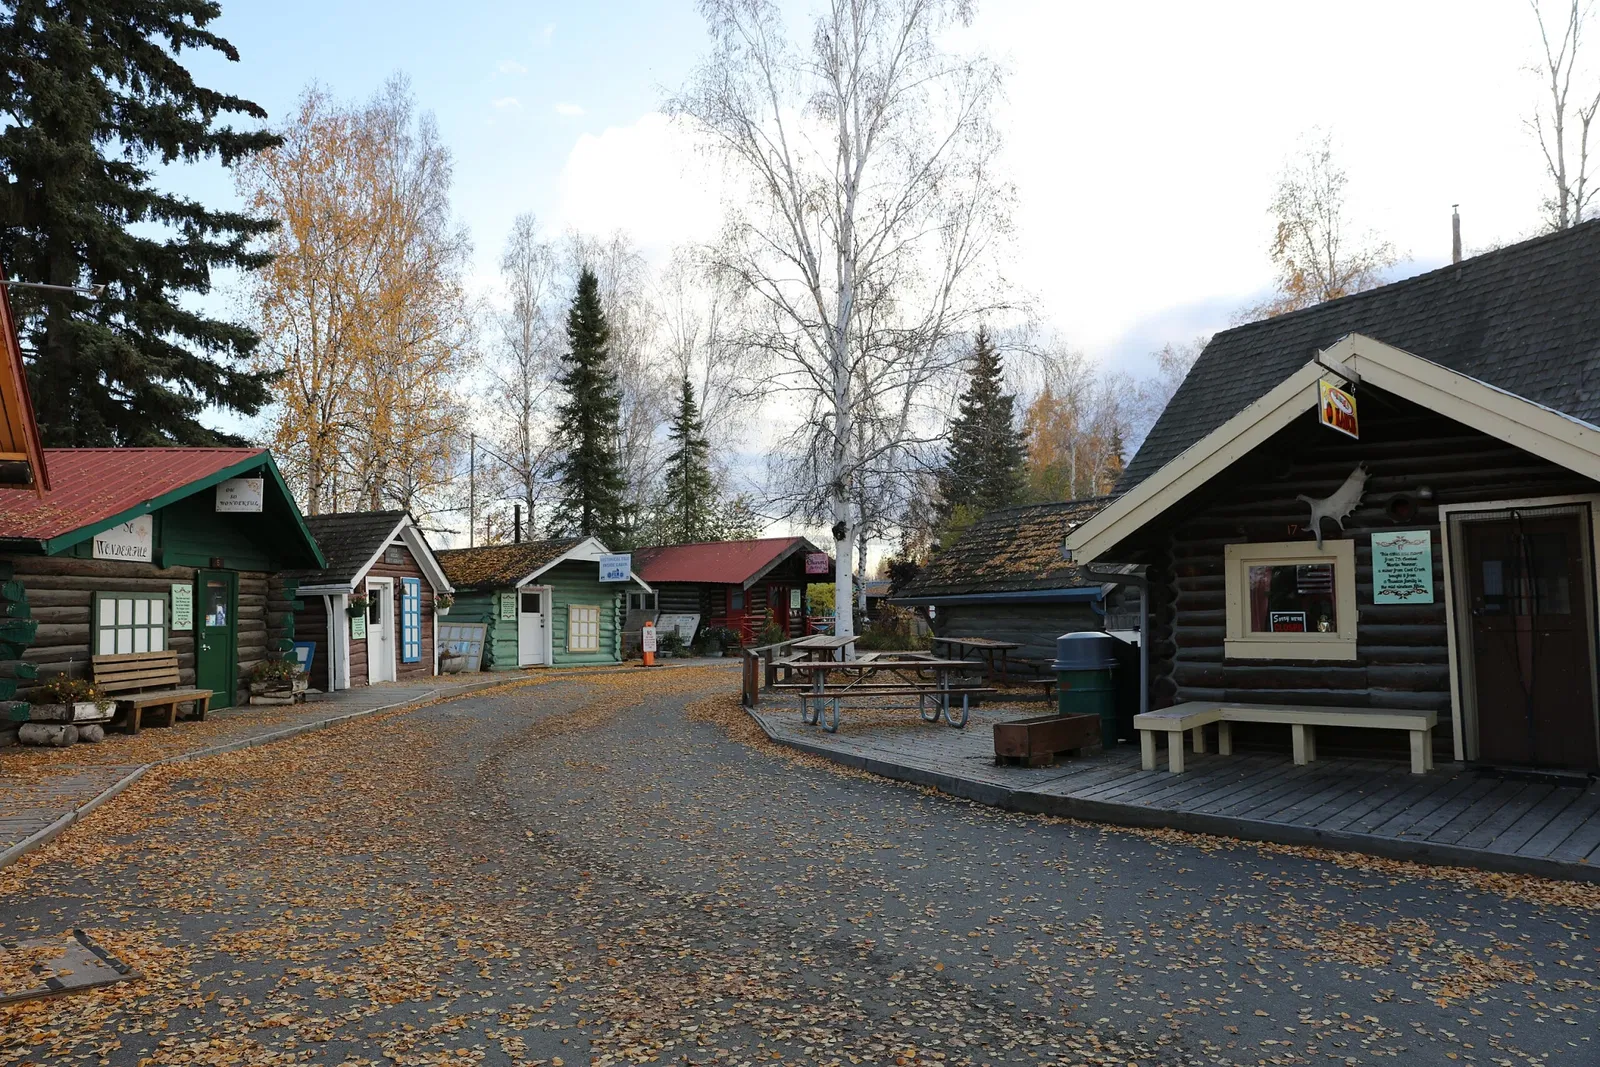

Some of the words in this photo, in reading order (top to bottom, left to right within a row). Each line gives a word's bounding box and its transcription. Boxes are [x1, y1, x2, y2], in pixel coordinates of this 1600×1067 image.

[1288, 524, 1298, 535] 17
[96, 540, 148, 558] WONDERFUL
[1274, 623, 1303, 632] CLOSED
